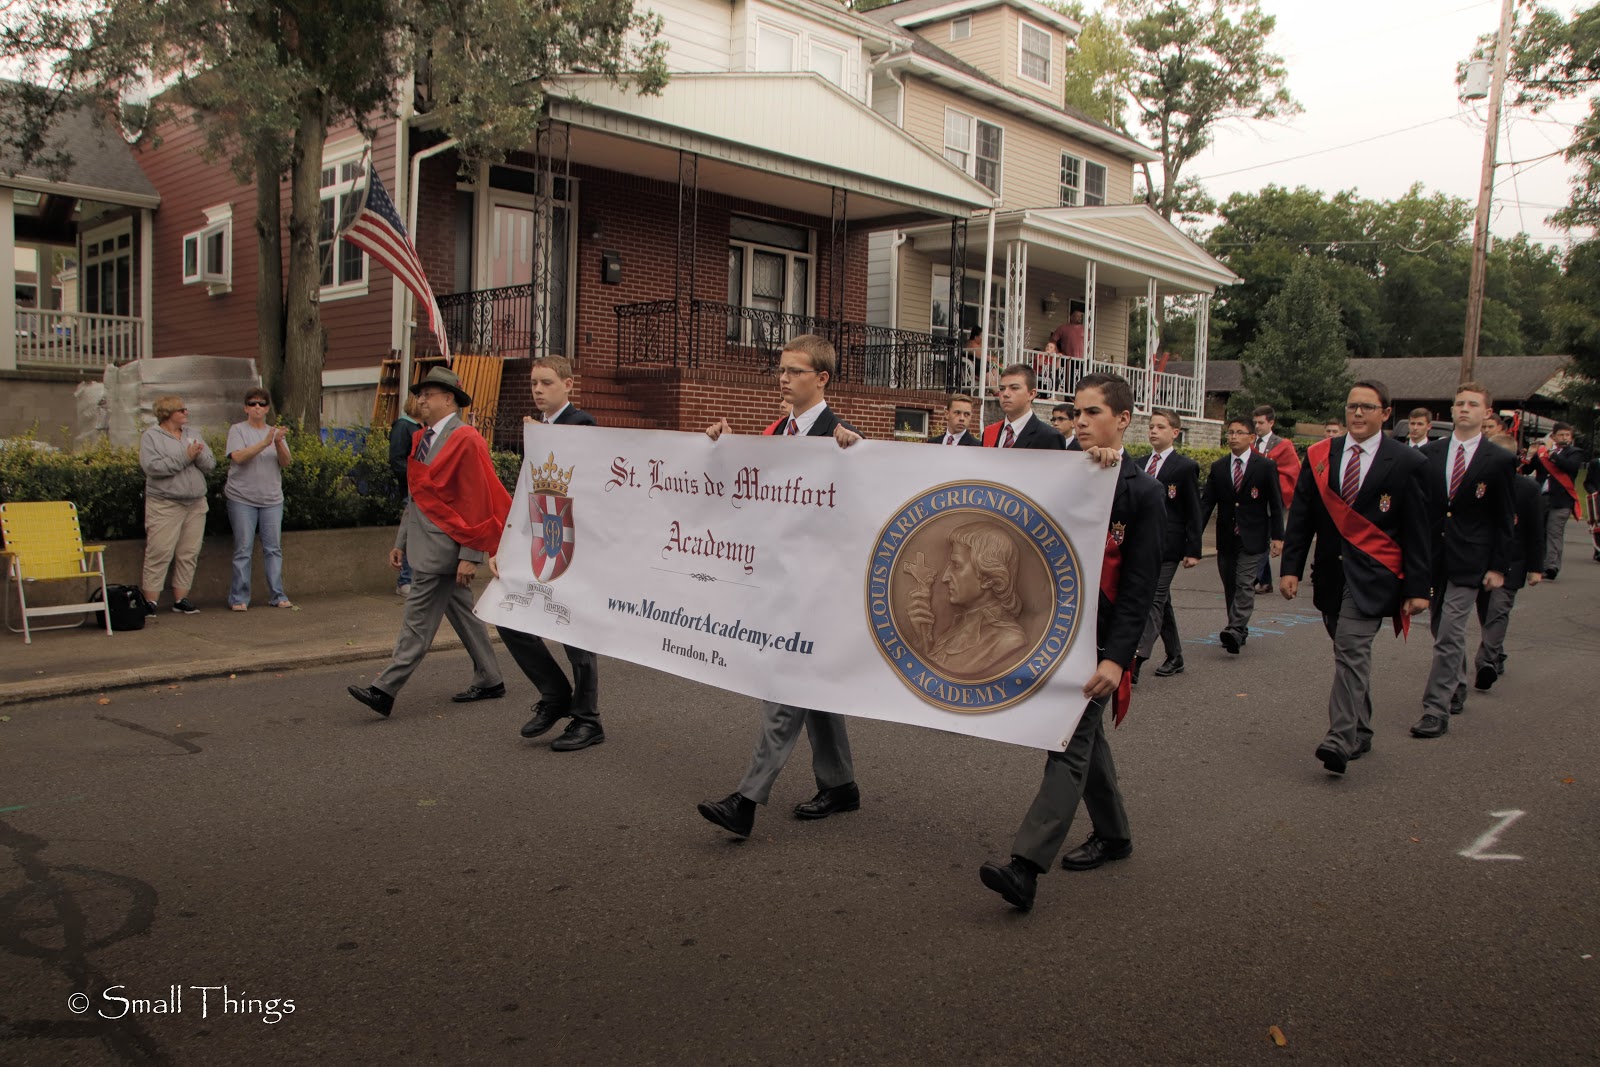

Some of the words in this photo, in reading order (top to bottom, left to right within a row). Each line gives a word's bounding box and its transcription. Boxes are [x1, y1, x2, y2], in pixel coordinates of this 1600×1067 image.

[605, 456, 642, 492] St.
[648, 459, 699, 499] Louis
[704, 472, 724, 497] de
[731, 466, 836, 509] Montfort
[930, 488, 1035, 528] GRIGNION
[661, 520, 756, 575] Academy
[878, 502, 930, 563] MARIE
[1031, 521, 1060, 554] DE
[871, 564, 889, 631] LOUIS
[1027, 553, 1076, 681] MONTFORT
[608, 598, 814, 655] www.MontfortAcademy.edu
[662, 637, 708, 665] Herndon,
[711, 650, 727, 667] Pa.
[912, 669, 1009, 704] ACADEMY
